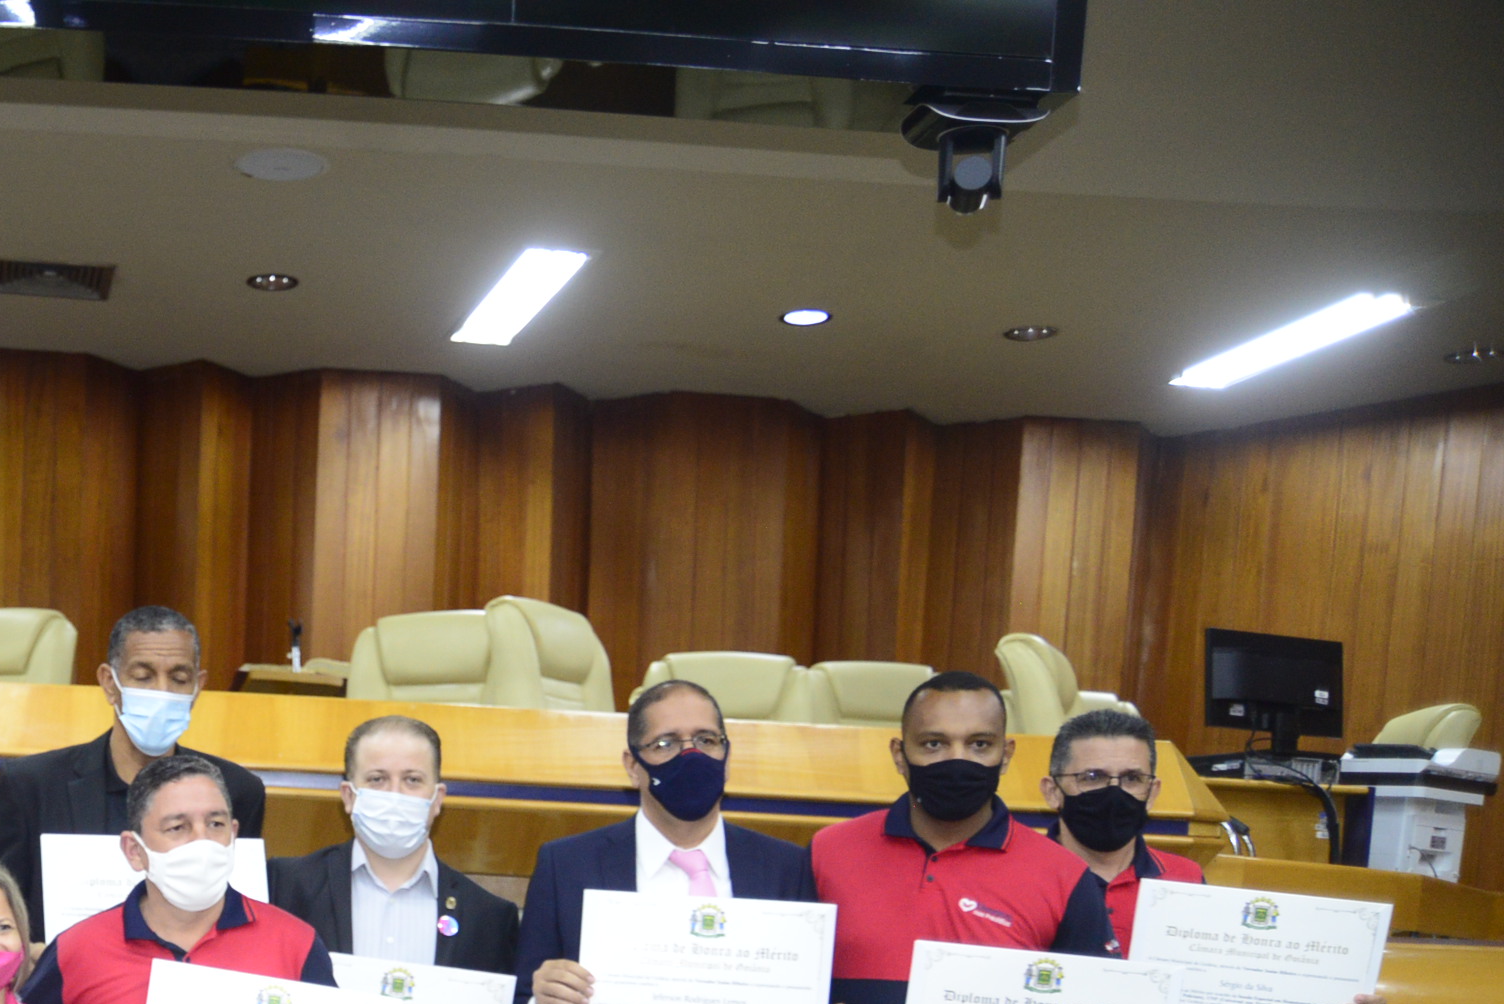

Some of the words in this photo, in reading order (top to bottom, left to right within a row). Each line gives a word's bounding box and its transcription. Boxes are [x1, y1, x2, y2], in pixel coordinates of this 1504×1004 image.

[1166, 925, 1219, 942] Diploma
[1224, 931, 1236, 943] de
[1286, 939, 1301, 950] ao
